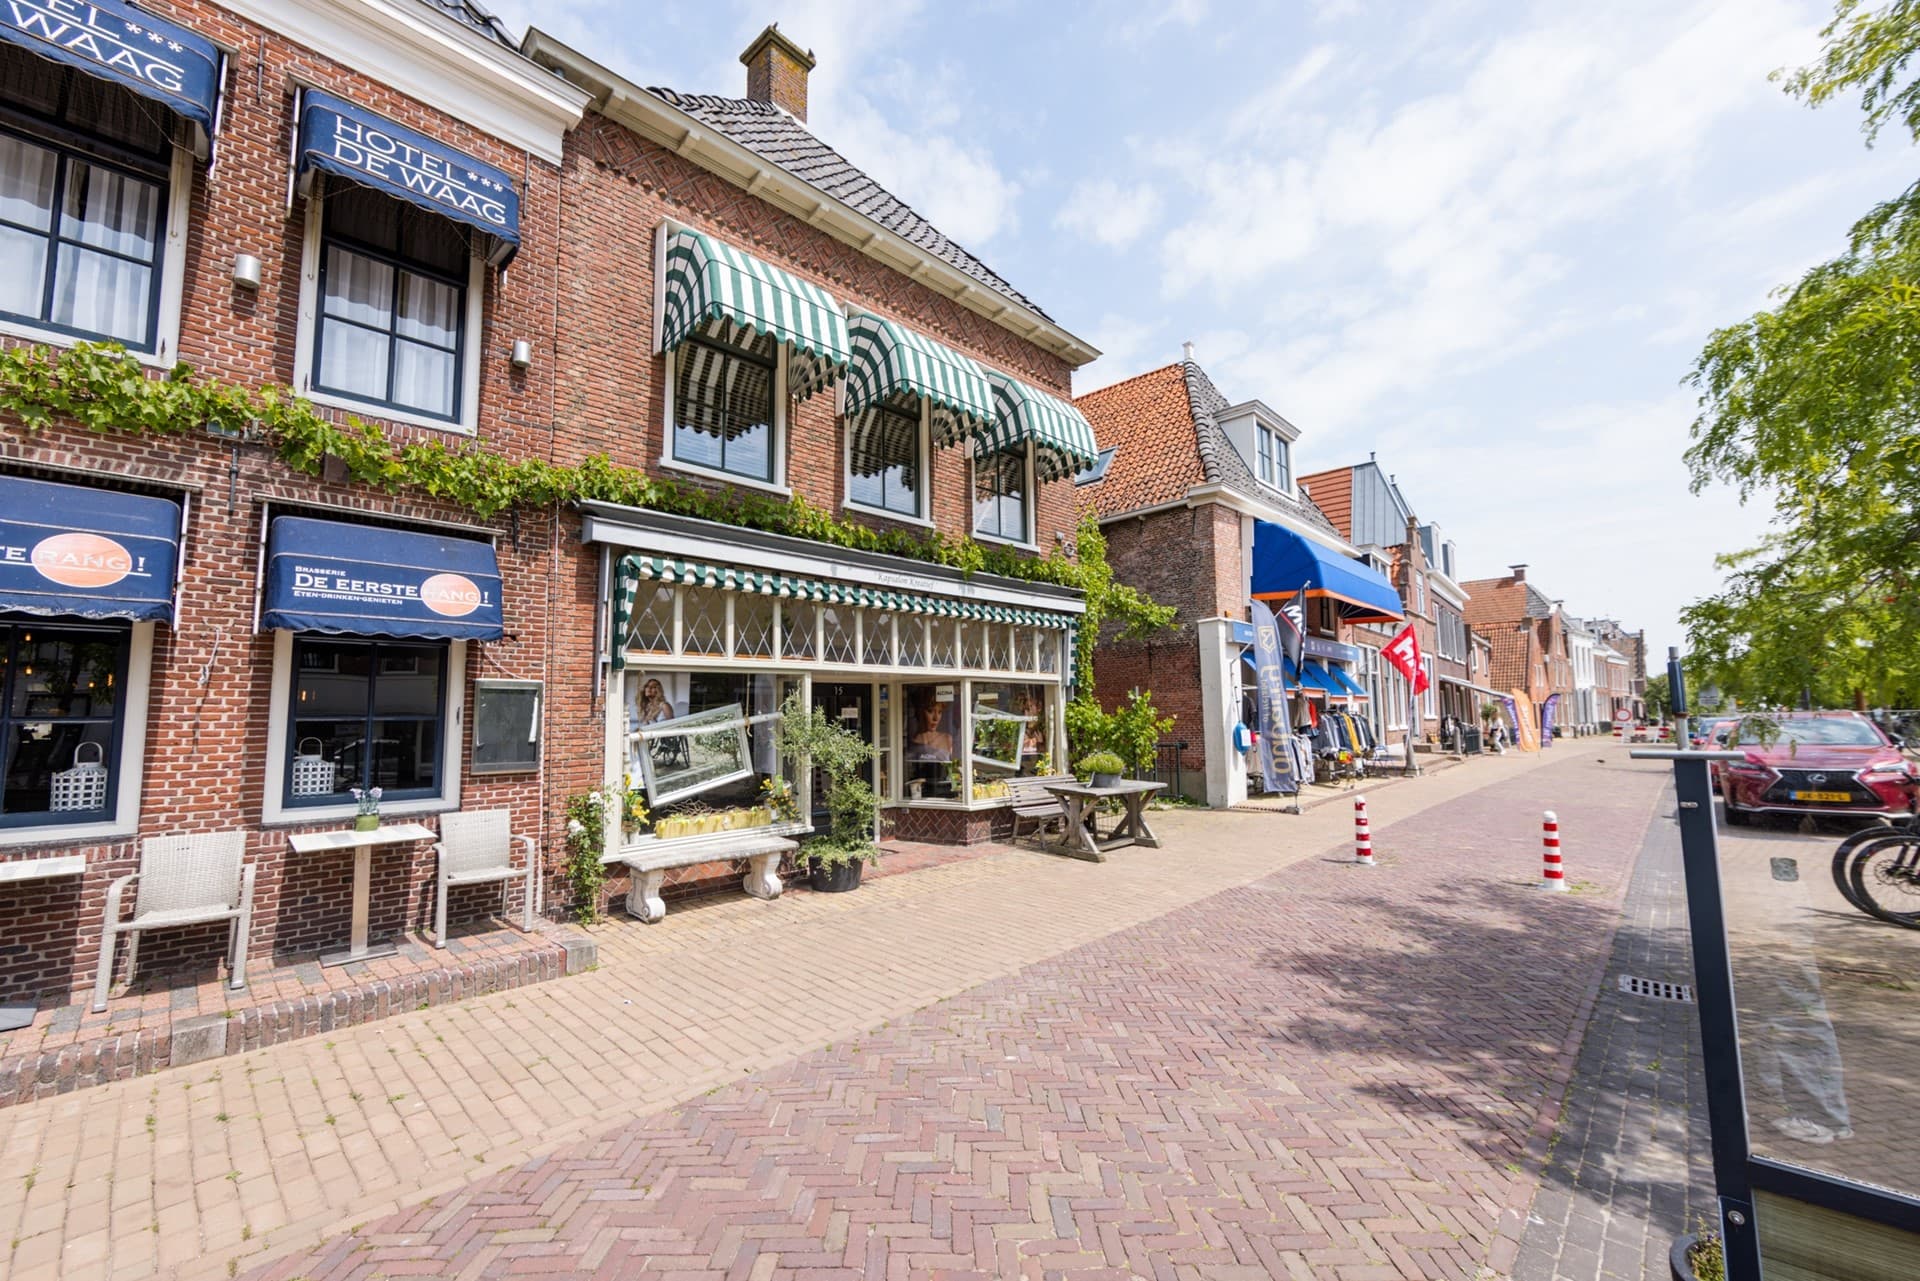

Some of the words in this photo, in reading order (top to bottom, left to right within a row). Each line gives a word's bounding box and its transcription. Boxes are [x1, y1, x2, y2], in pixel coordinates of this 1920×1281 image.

[7, 0, 184, 92] WAAG
[335, 115, 466, 187] HOTEL
[333, 139, 390, 179] DE
[399, 166, 507, 225] WAAG
[38, 550, 127, 570] RANG
[294, 565, 347, 576] BRASSERIE
[294, 573, 329, 589] DE
[336, 579, 419, 597] EERSTE
[293, 590, 403, 605] ETEN-DRINKEN-GENIETEN
[833, 686, 844, 696] 15
